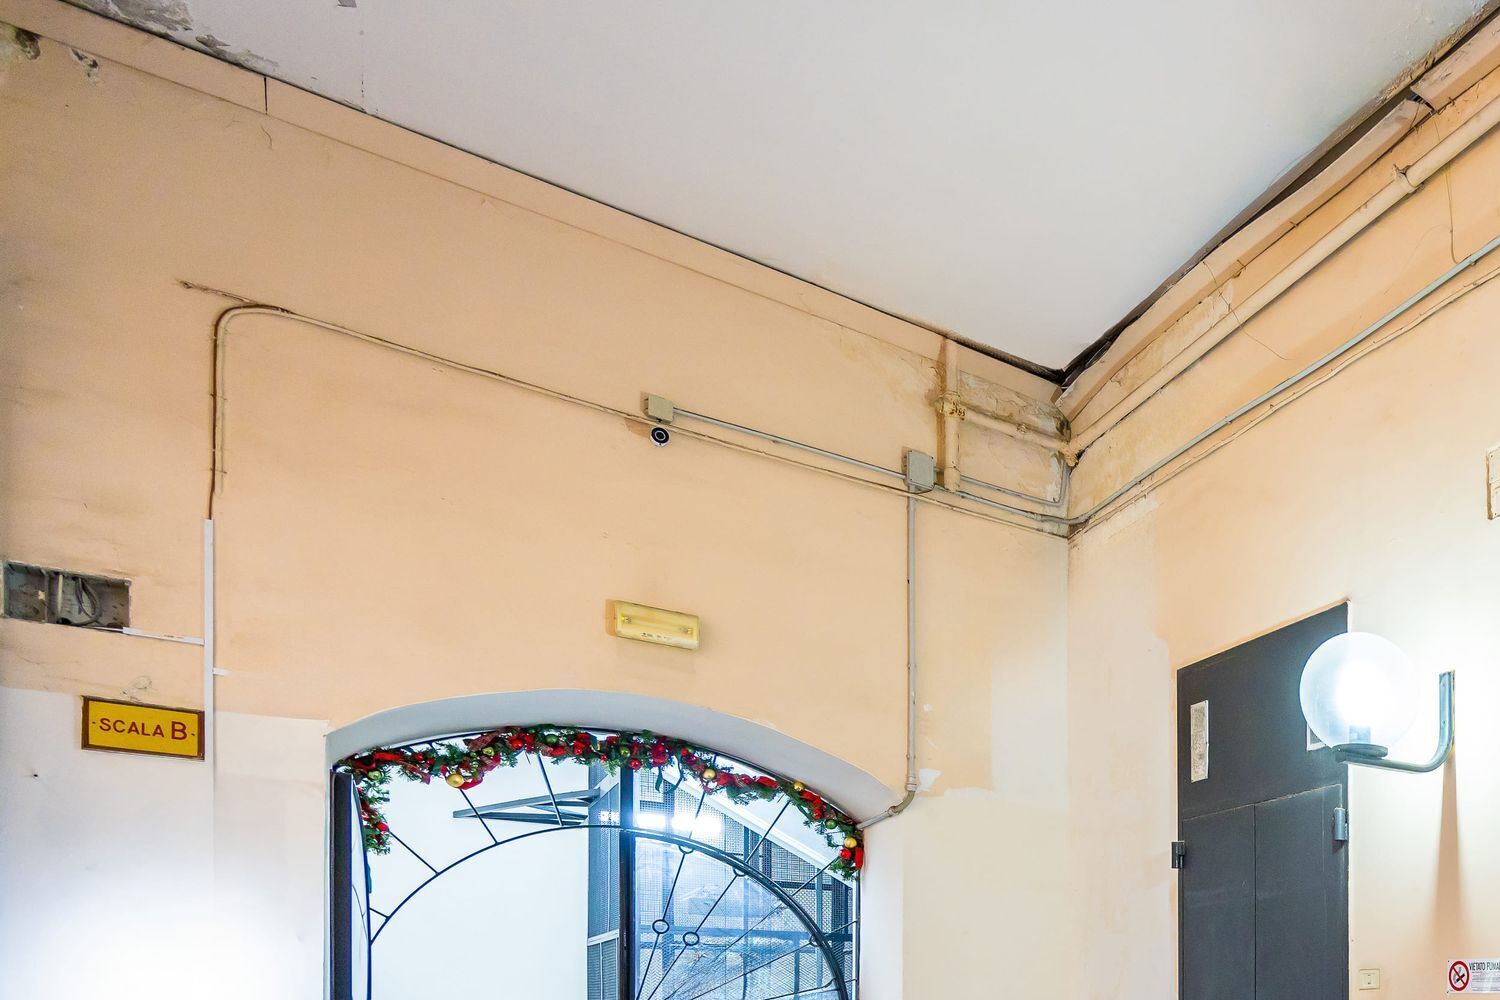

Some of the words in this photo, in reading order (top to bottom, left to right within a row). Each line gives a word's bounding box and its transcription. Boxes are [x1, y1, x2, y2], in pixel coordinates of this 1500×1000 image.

[99, 718, 164, 738] SCALA
[171, 721, 187, 740] B
[1469, 962, 1485, 970] VIETATO
